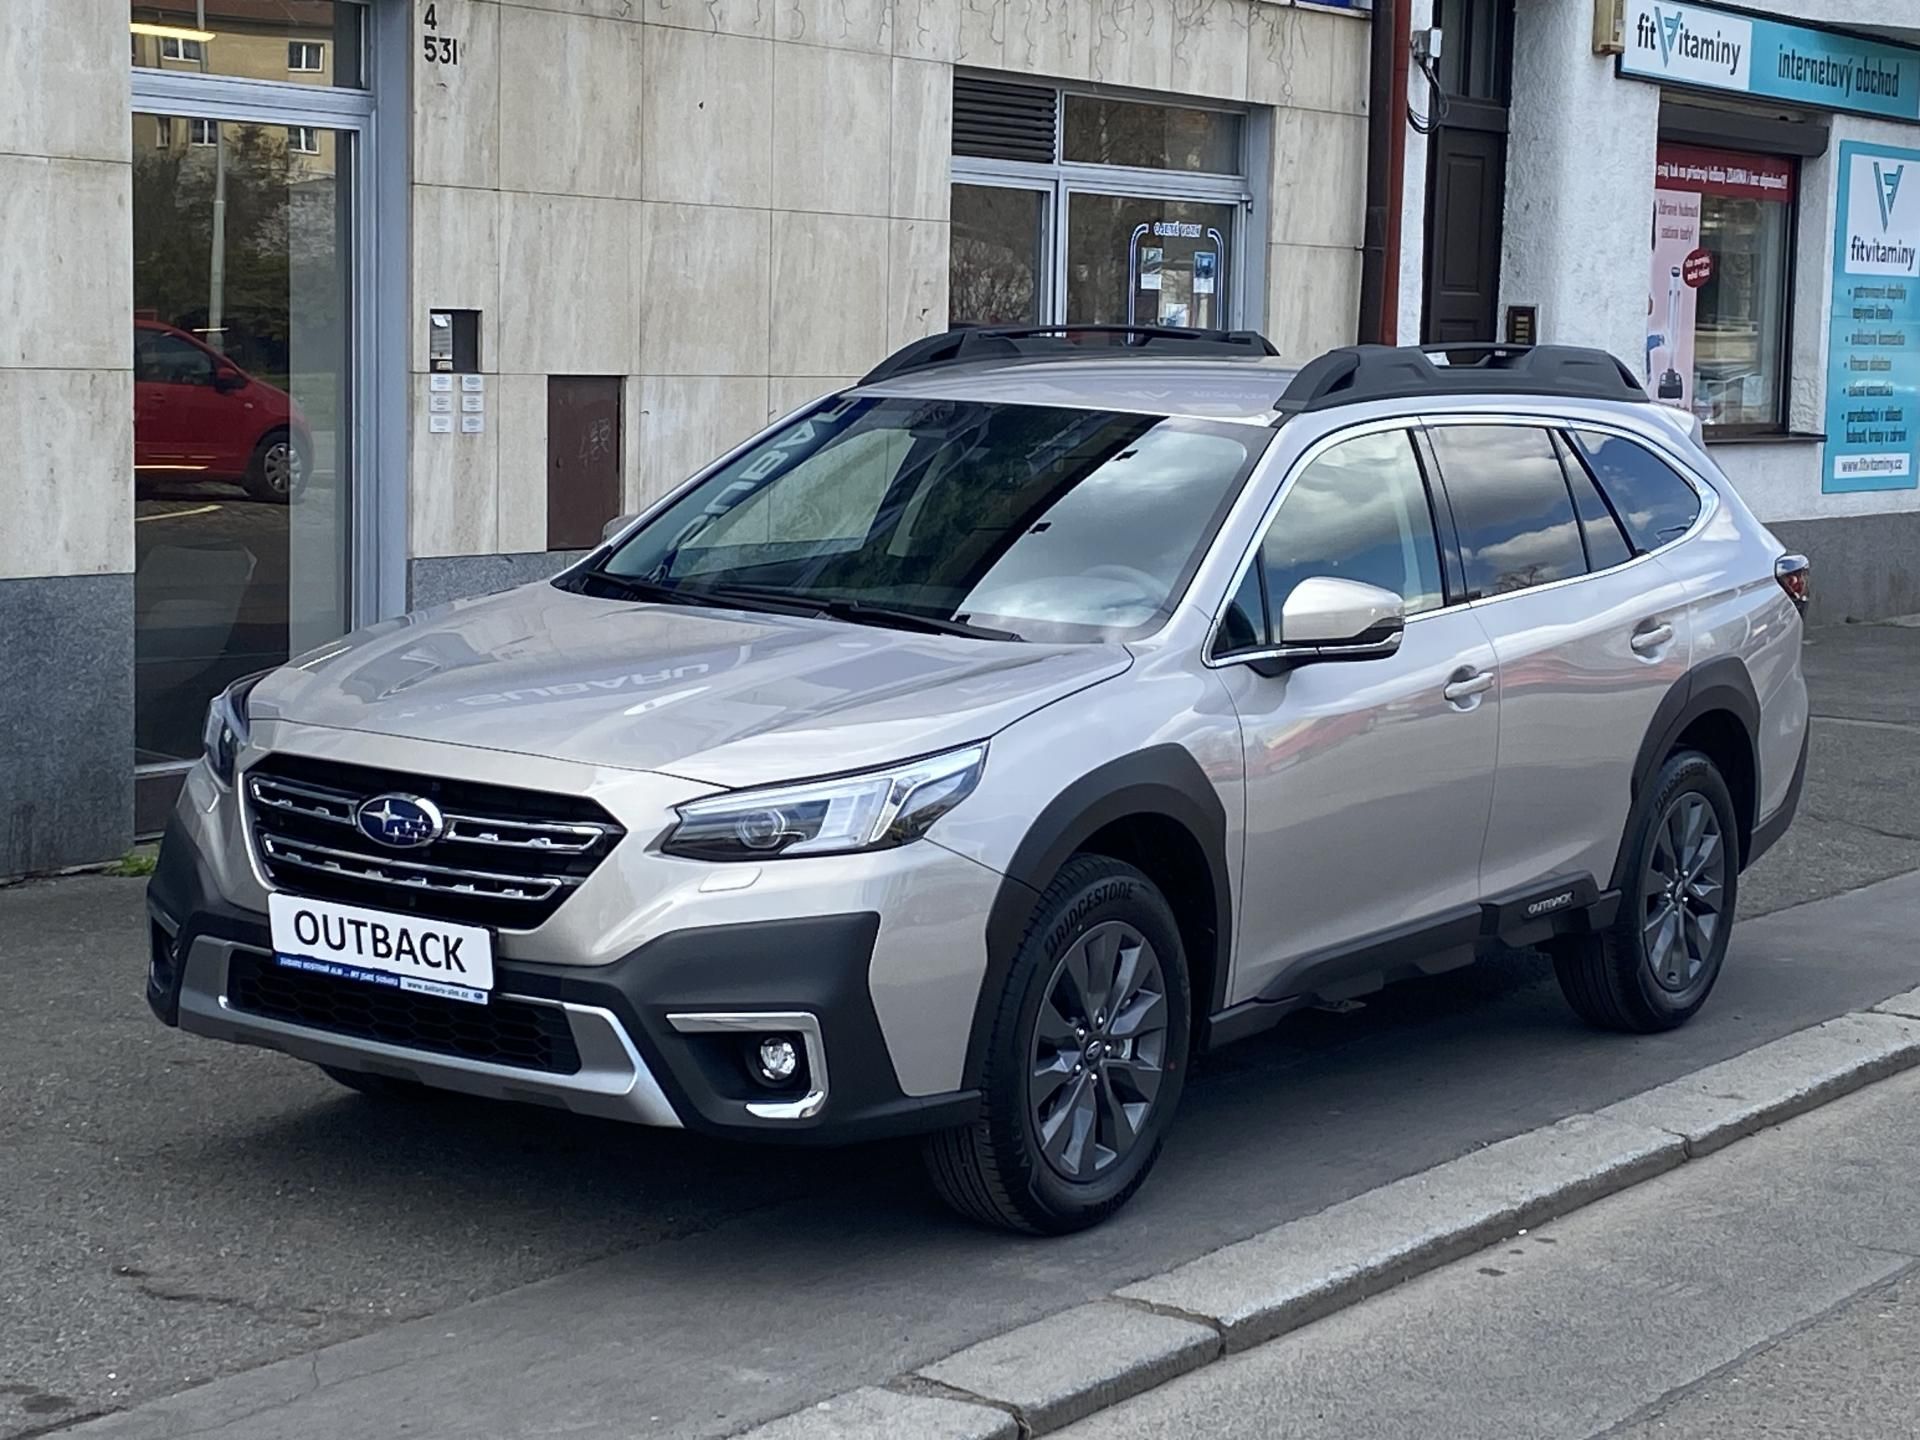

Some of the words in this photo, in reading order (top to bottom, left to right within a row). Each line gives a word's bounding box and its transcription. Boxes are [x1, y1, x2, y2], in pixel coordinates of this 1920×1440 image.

[424, 3, 437, 30] 4
[424, 35, 457, 65] 531
[1778, 43, 1853, 98] internetový
[1856, 56, 1900, 97] obchod
[1851, 235, 1915, 271] fitvitaminy
[294, 910, 467, 973] OUTBACK
